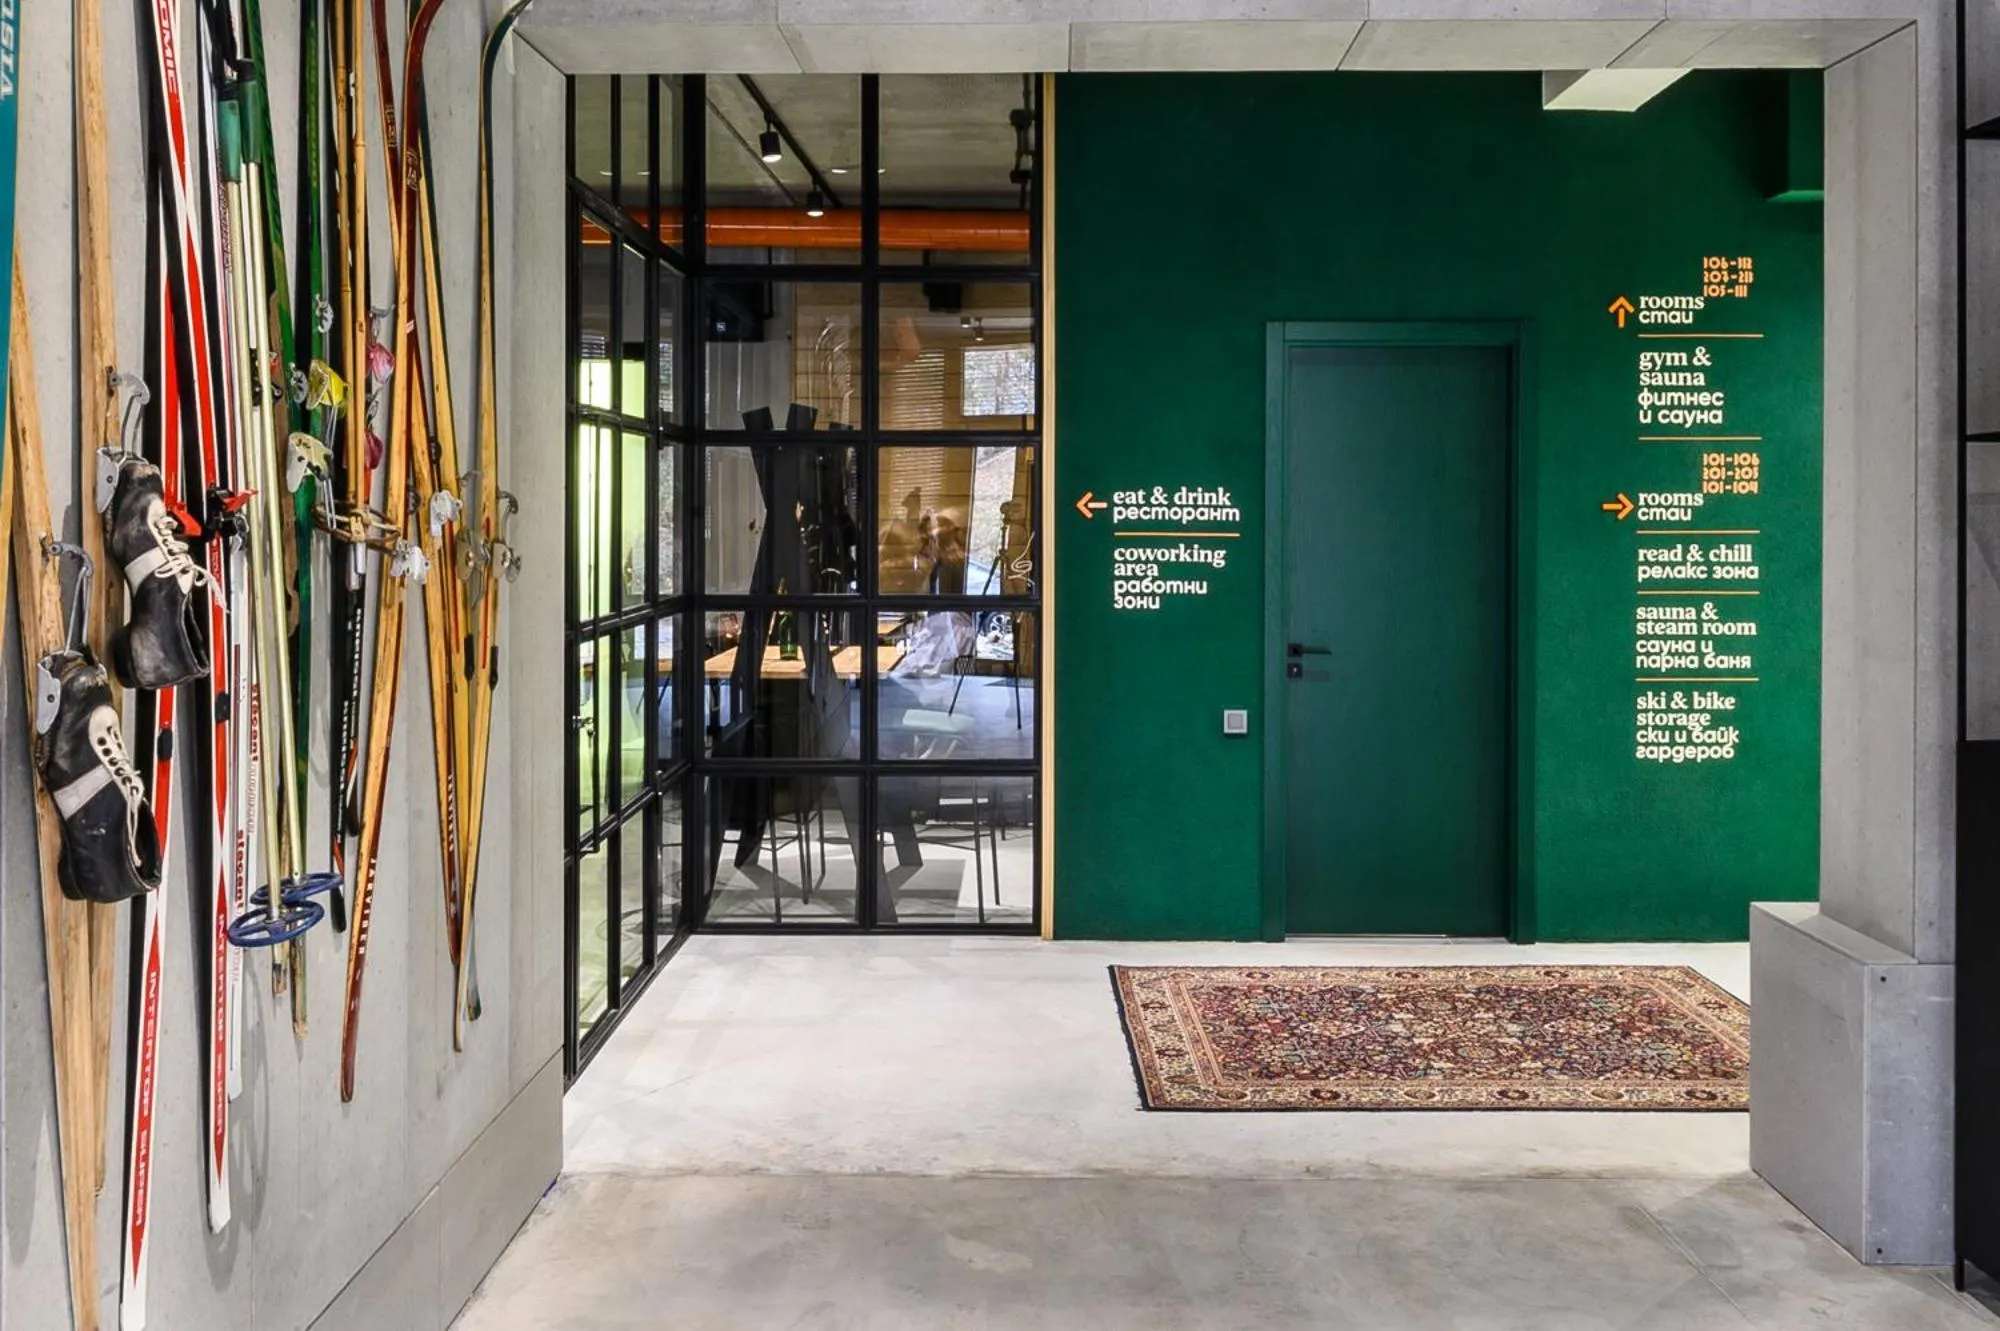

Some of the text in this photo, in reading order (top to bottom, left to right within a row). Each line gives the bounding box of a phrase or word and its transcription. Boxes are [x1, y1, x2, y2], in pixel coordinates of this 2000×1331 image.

[1639, 295, 1705, 309] rooms
[1638, 309, 1693, 324] стаи
[1639, 346, 1712, 371] gym &
[1639, 371, 1705, 386] sauna
[1638, 388, 1724, 410] фитнес
[1639, 409, 1723, 428] и сауна
[1113, 486, 1231, 505] eat & drink
[1638, 492, 1704, 506] rooms
[1113, 506, 1240, 524] ресторант
[1638, 506, 1692, 521] стаи
[1113, 543, 1227, 568] coworking
[1638, 544, 1752, 561] read & chill
[1113, 562, 1159, 577] area
[1638, 561, 1759, 582] релакс зона
[1113, 576, 1207, 596] работни
[1113, 595, 1160, 609] зони
[1636, 602, 1718, 620] sauna &
[1636, 621, 1757, 636] steam room
[1636, 639, 1713, 656] сауна и
[1636, 652, 1752, 672] парна баня
[1636, 691, 1736, 710] ski & bike
[1636, 711, 1711, 730] storage
[1636, 726, 1739, 743] ски и байк
[1636, 743, 1735, 763] гардероб
[135, 971, 157, 1228] INTERTOP SUPER
